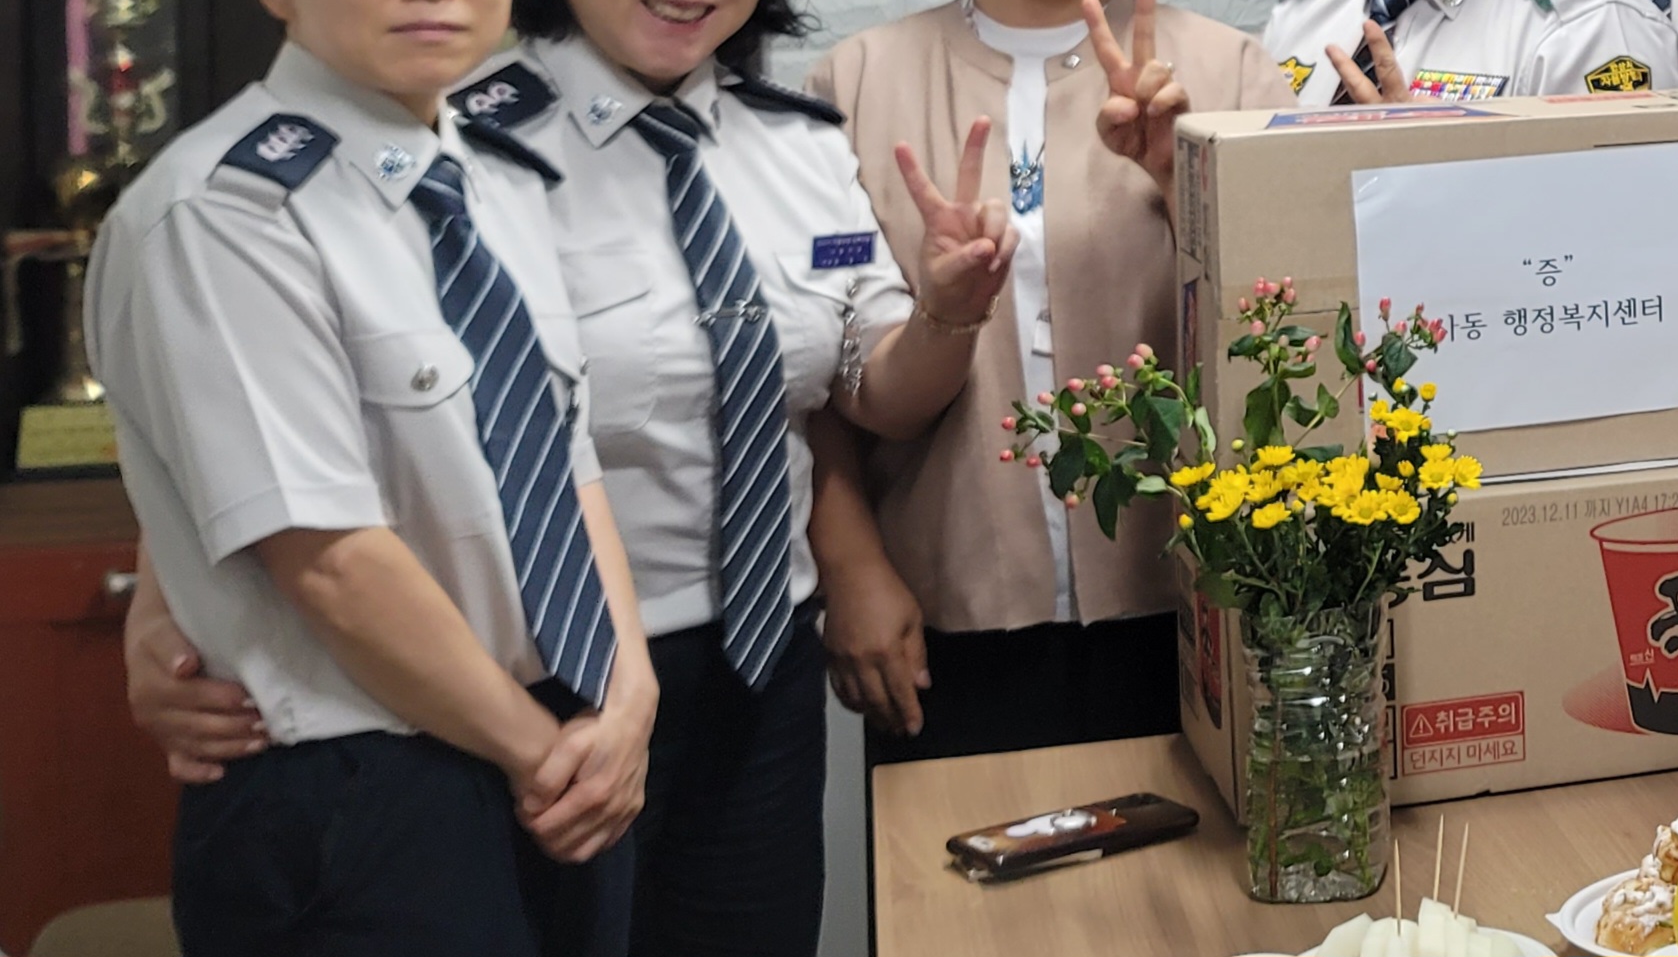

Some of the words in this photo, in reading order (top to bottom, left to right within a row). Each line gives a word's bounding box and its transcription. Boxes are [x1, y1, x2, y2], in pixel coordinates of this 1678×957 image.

[1503, 295, 1663, 337] 행정복지센터
[1502, 502, 1578, 526] 2023.12.11
[1436, 702, 1516, 733] 취급주의
[1410, 746, 1461, 770] 던지지
